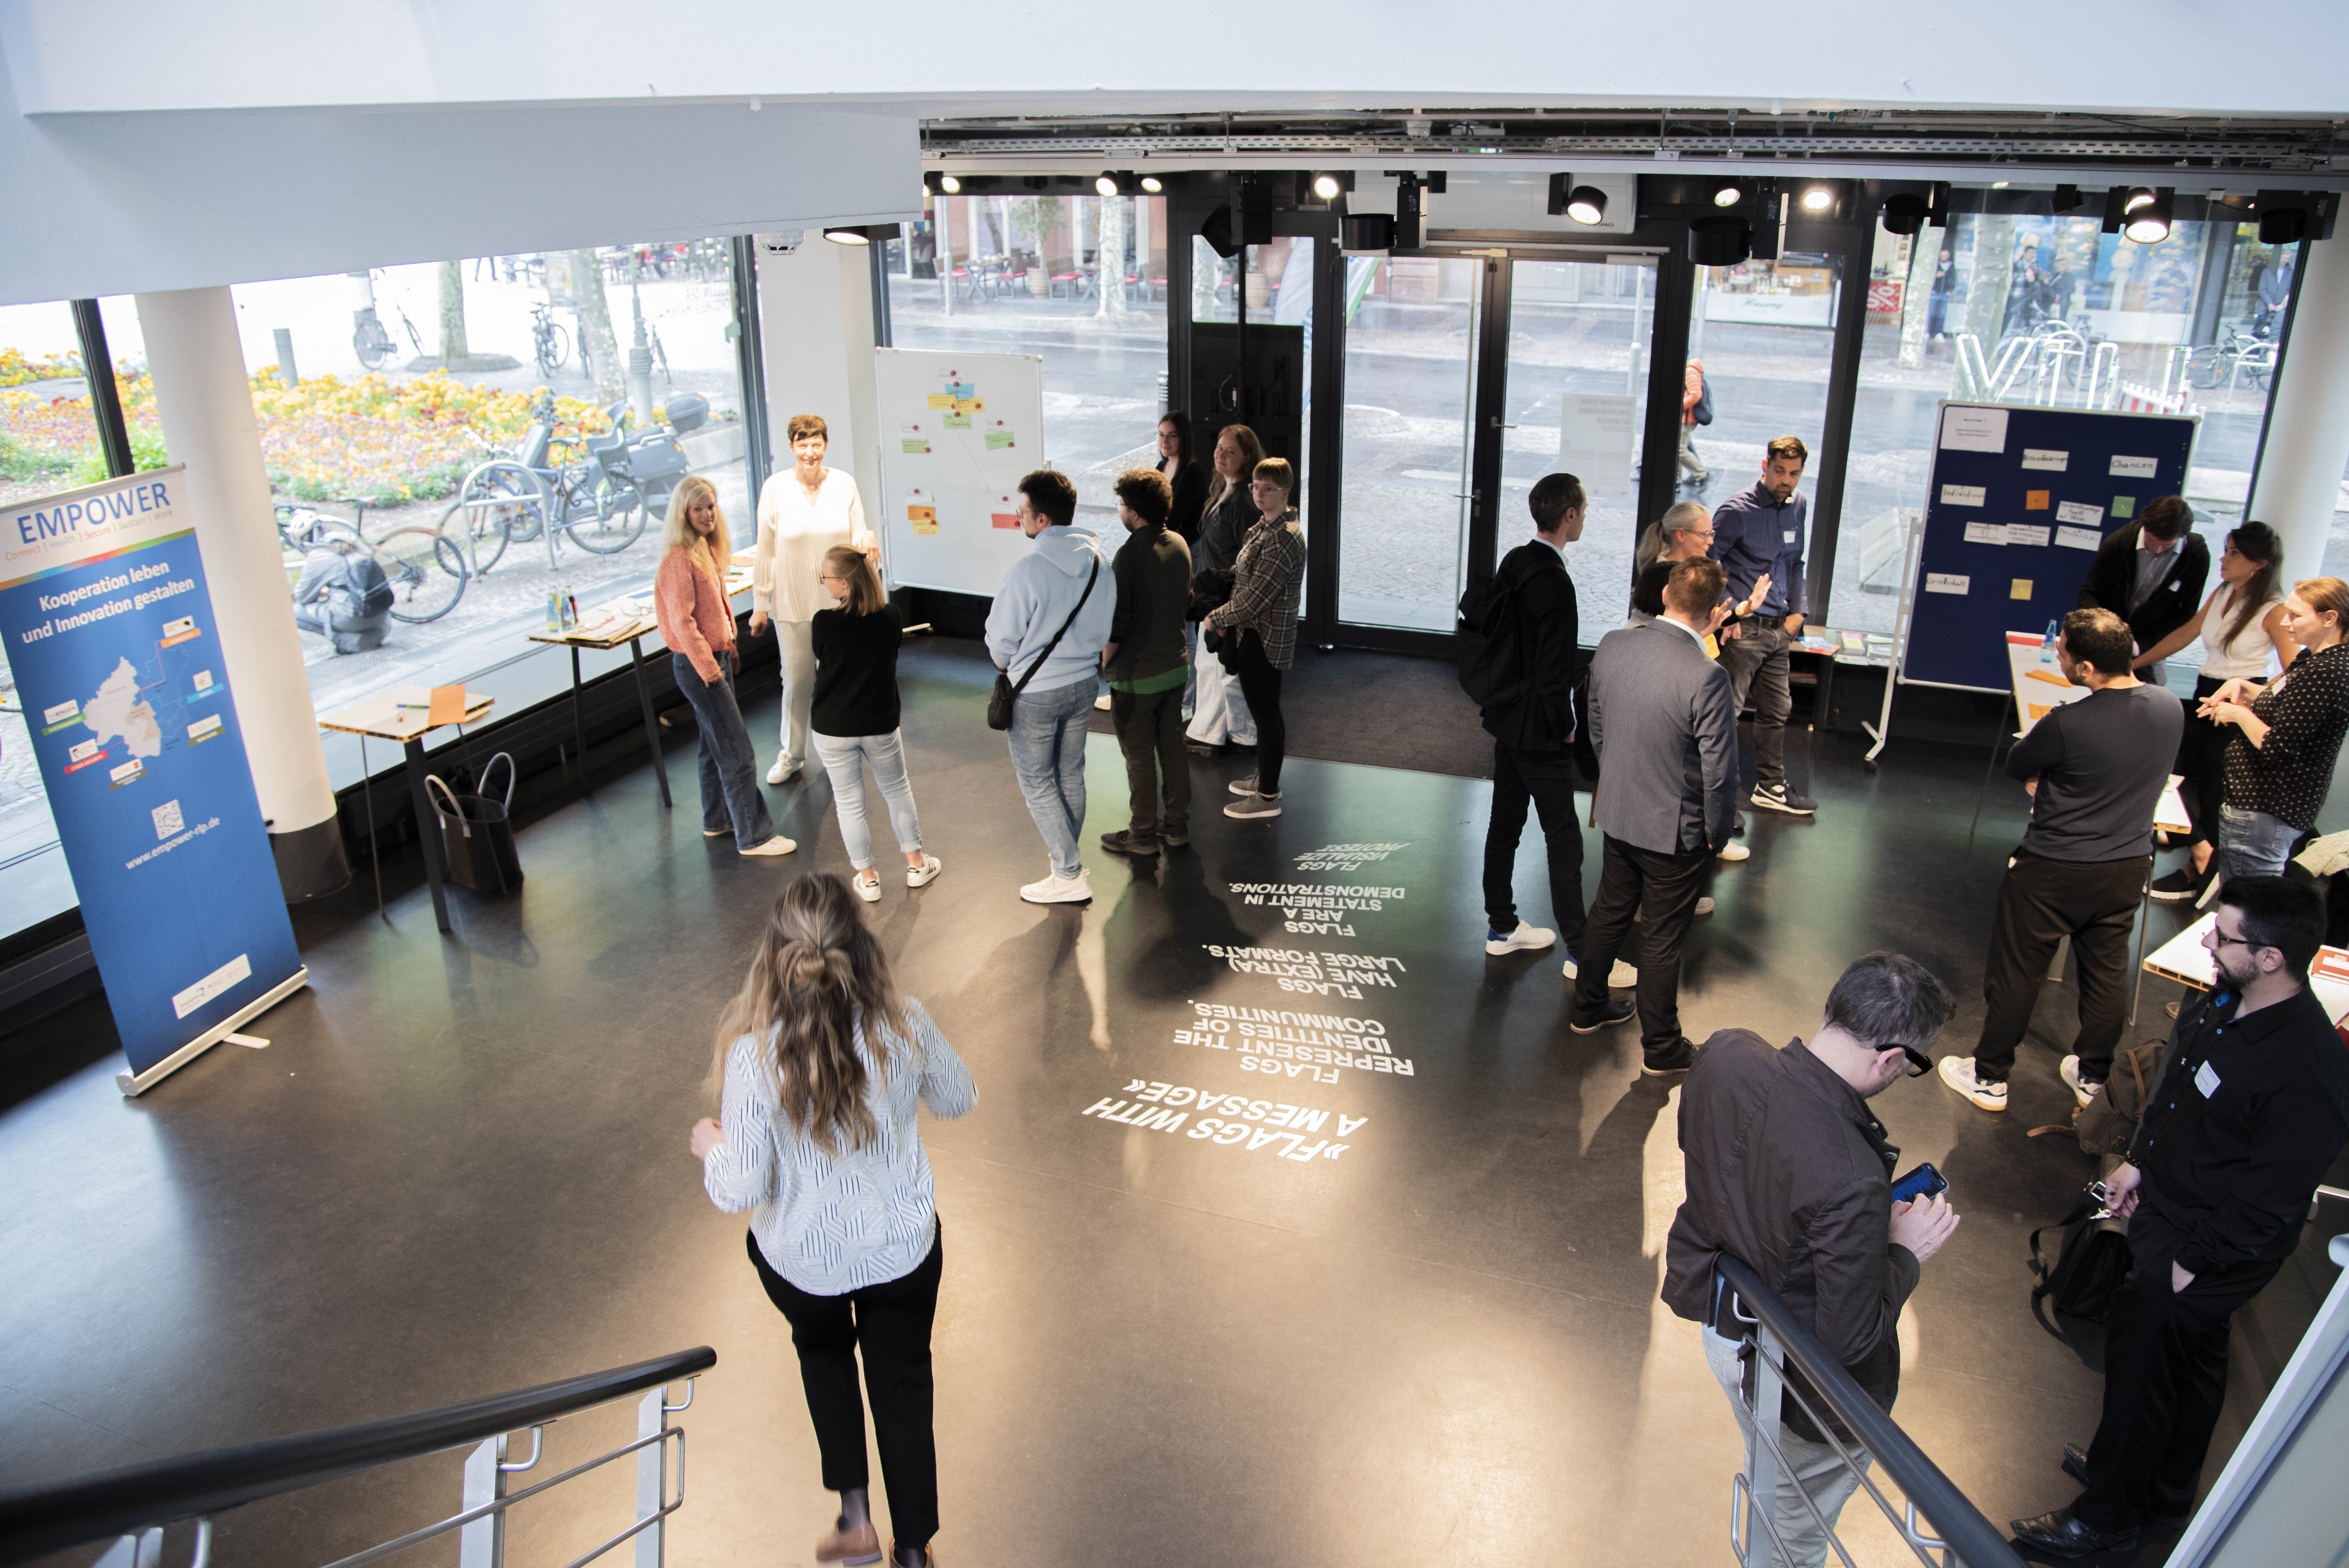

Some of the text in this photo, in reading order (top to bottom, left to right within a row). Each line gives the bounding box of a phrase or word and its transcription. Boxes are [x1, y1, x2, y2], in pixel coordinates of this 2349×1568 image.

[2111, 459, 2153, 469] Chancen
[17, 482, 170, 544] EMPOWER
[5, 509, 173, 561] Connect Health Secure Sustain Work
[39, 562, 170, 612] Kooperation leben
[22, 578, 195, 644] und Innovation gestalten
[126, 817, 221, 869] www.empower-rlp.de
[1292, 851, 1391, 861] VISUALIZE
[1297, 861, 1362, 871] FLAGS
[1229, 883, 1405, 899] DEMONSTRATIONS.
[1245, 895, 1381, 911] STATEMENT IN
[1283, 908, 1343, 922] ARE A
[1285, 921, 1355, 936] FLAGS
[1203, 945, 1406, 972] LARGE FORMATS.
[1229, 958, 1397, 988] HAVE (EXTRA)
[1277, 978, 1363, 999] FLAGS
[1188, 1000, 1385, 1036] COMMUNITIES.
[1193, 1018, 1392, 1054] IDENTITIES OF
[1173, 1030, 1414, 1076] REPRESENT THE
[1240, 1056, 1339, 1084] FLAGS
[1122, 1079, 1368, 1137] A MESSAGE«
[1082, 1098, 1350, 1162] »FLAGS WITH
